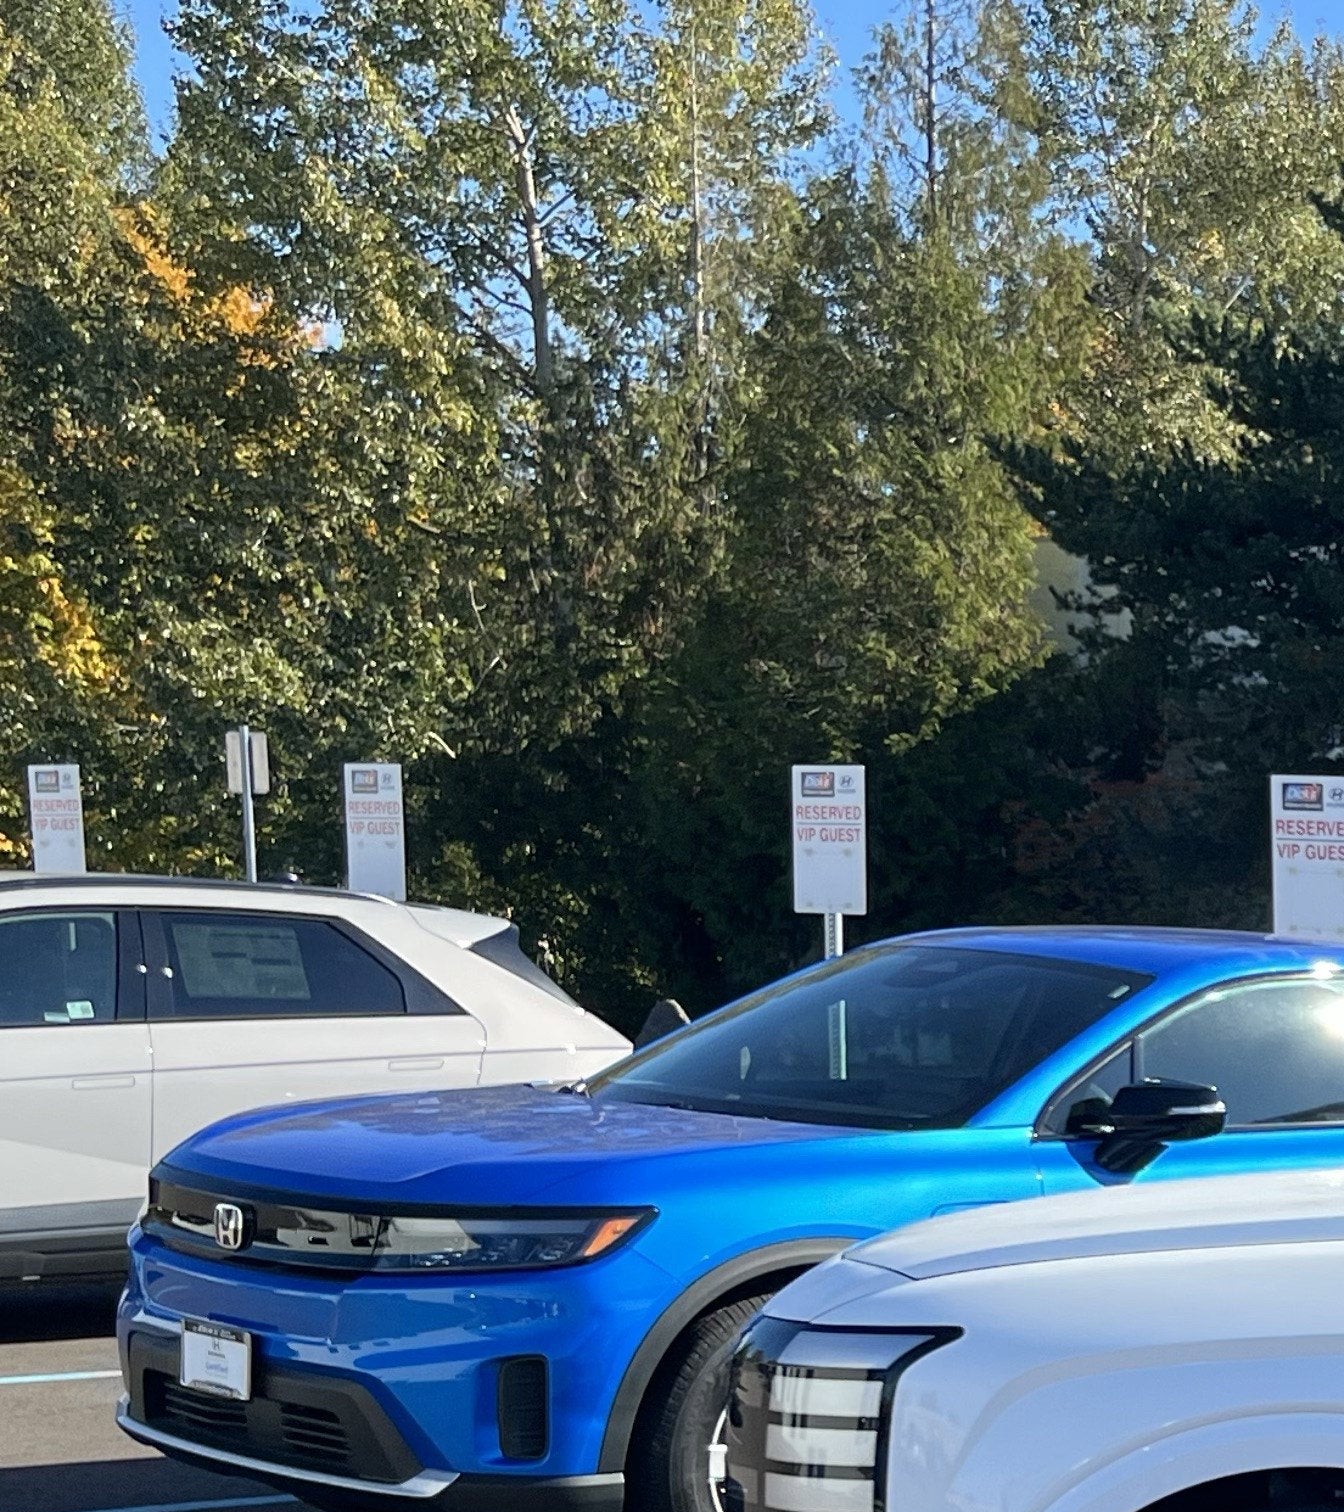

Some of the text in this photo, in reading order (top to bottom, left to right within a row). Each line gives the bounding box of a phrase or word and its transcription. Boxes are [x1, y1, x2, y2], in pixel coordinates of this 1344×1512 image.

[348, 801, 400, 814] RESERVED
[796, 805, 862, 820] RESERVED
[349, 821, 400, 835] VIP GUEST
[797, 827, 861, 842] VIP GUEST
[1277, 843, 1300, 859] VIP
